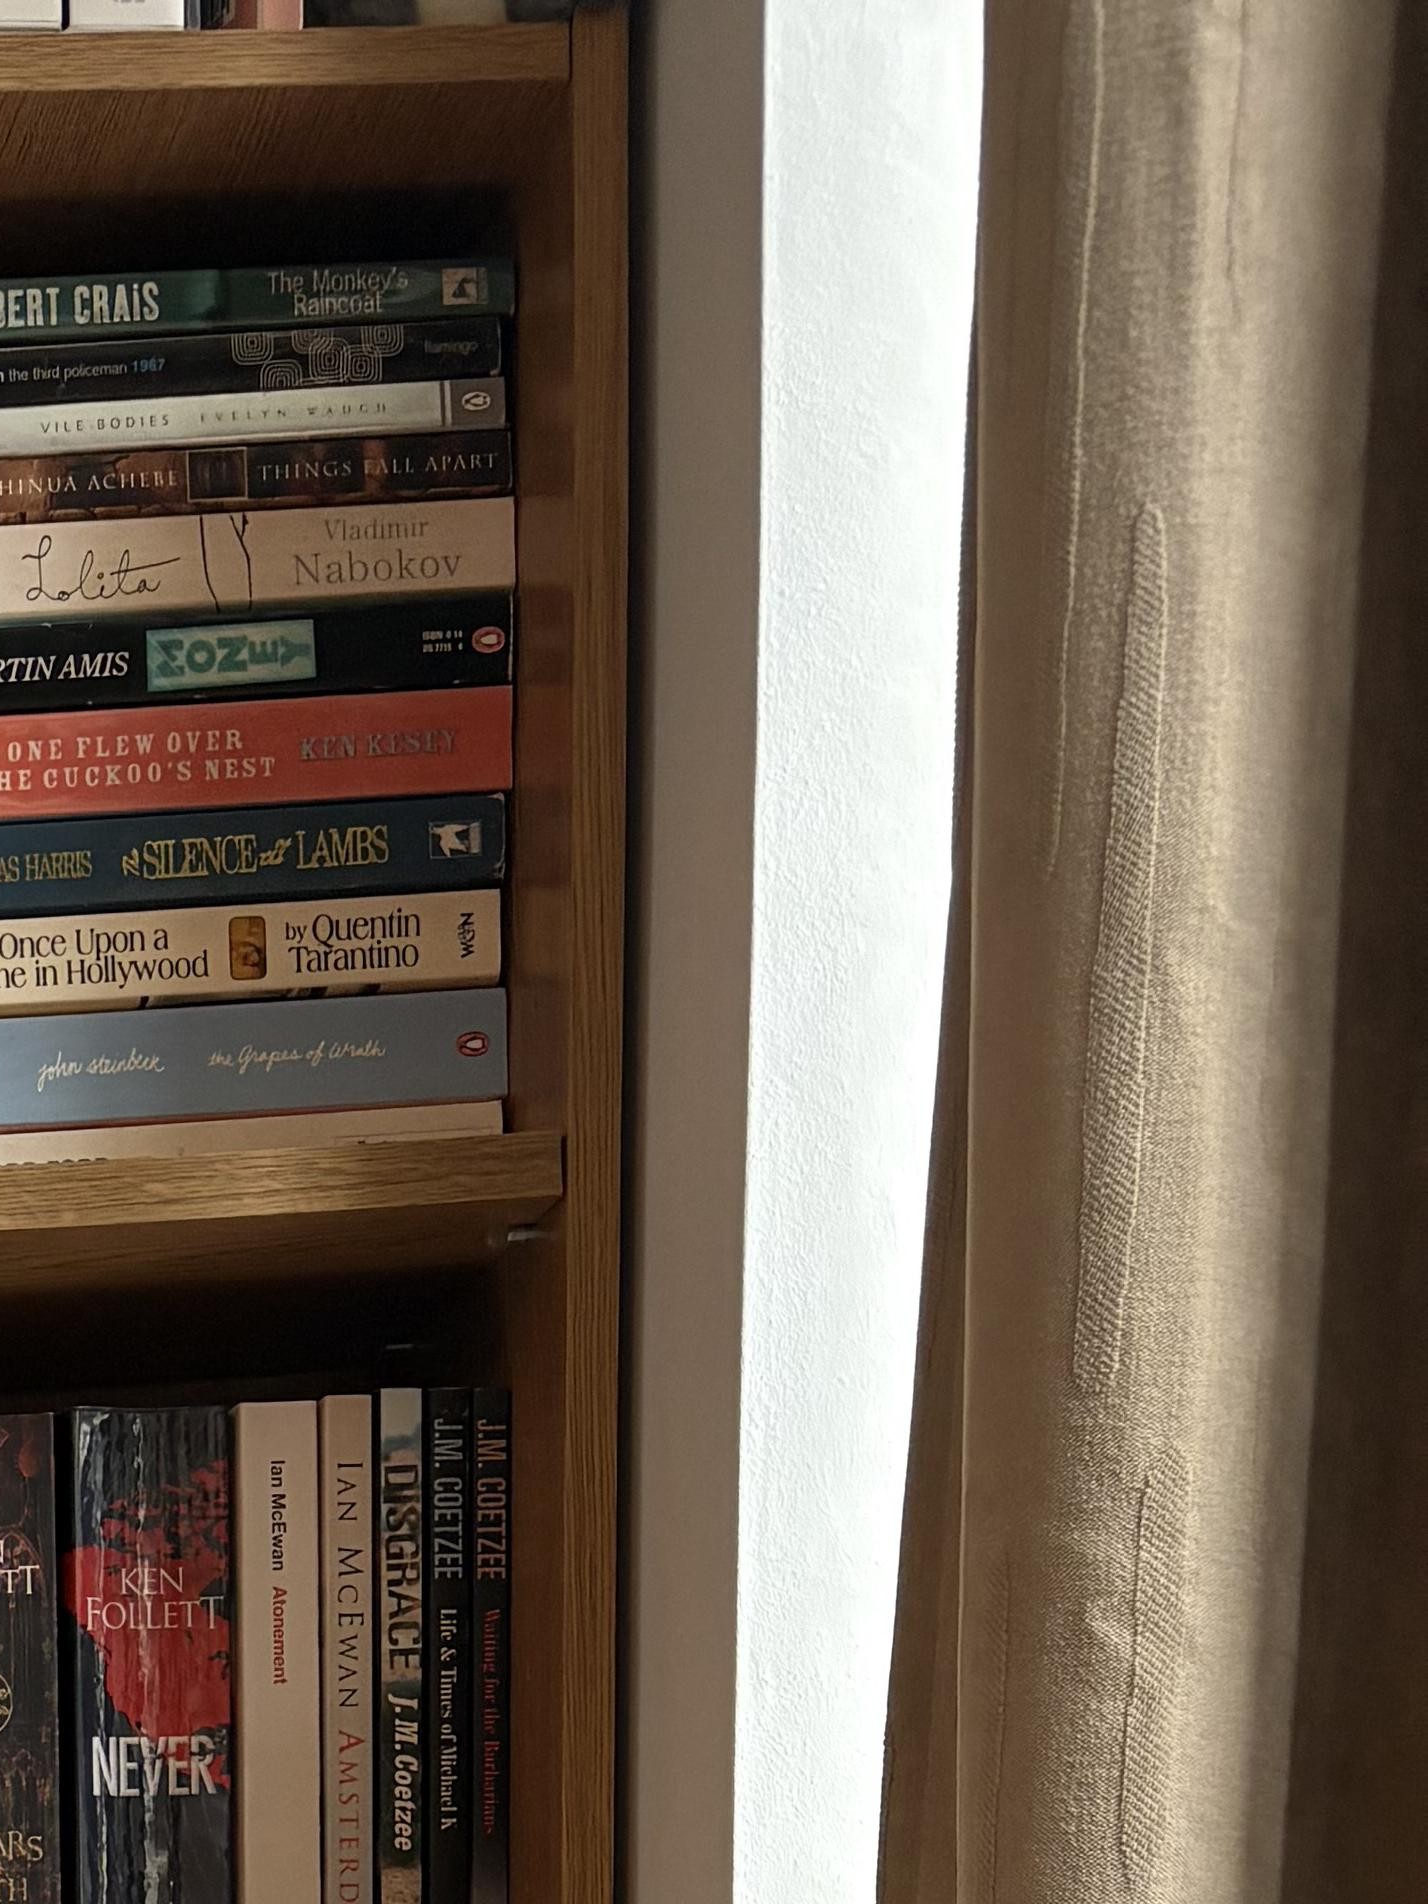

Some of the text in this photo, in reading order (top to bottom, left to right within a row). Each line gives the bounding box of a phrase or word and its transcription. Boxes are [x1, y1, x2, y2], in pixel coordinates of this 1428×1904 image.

[60, 651, 129, 679] AMIS
[285, 908, 422, 943] by Quentin
[75, 929, 146, 963] Upon
[153, 931, 169, 951] a
[290, 942, 419, 974] Tarantino
[34, 959, 59, 986] in
[66, 949, 210, 987] Hollywood
[91, 1736, 217, 1798] NEVER
